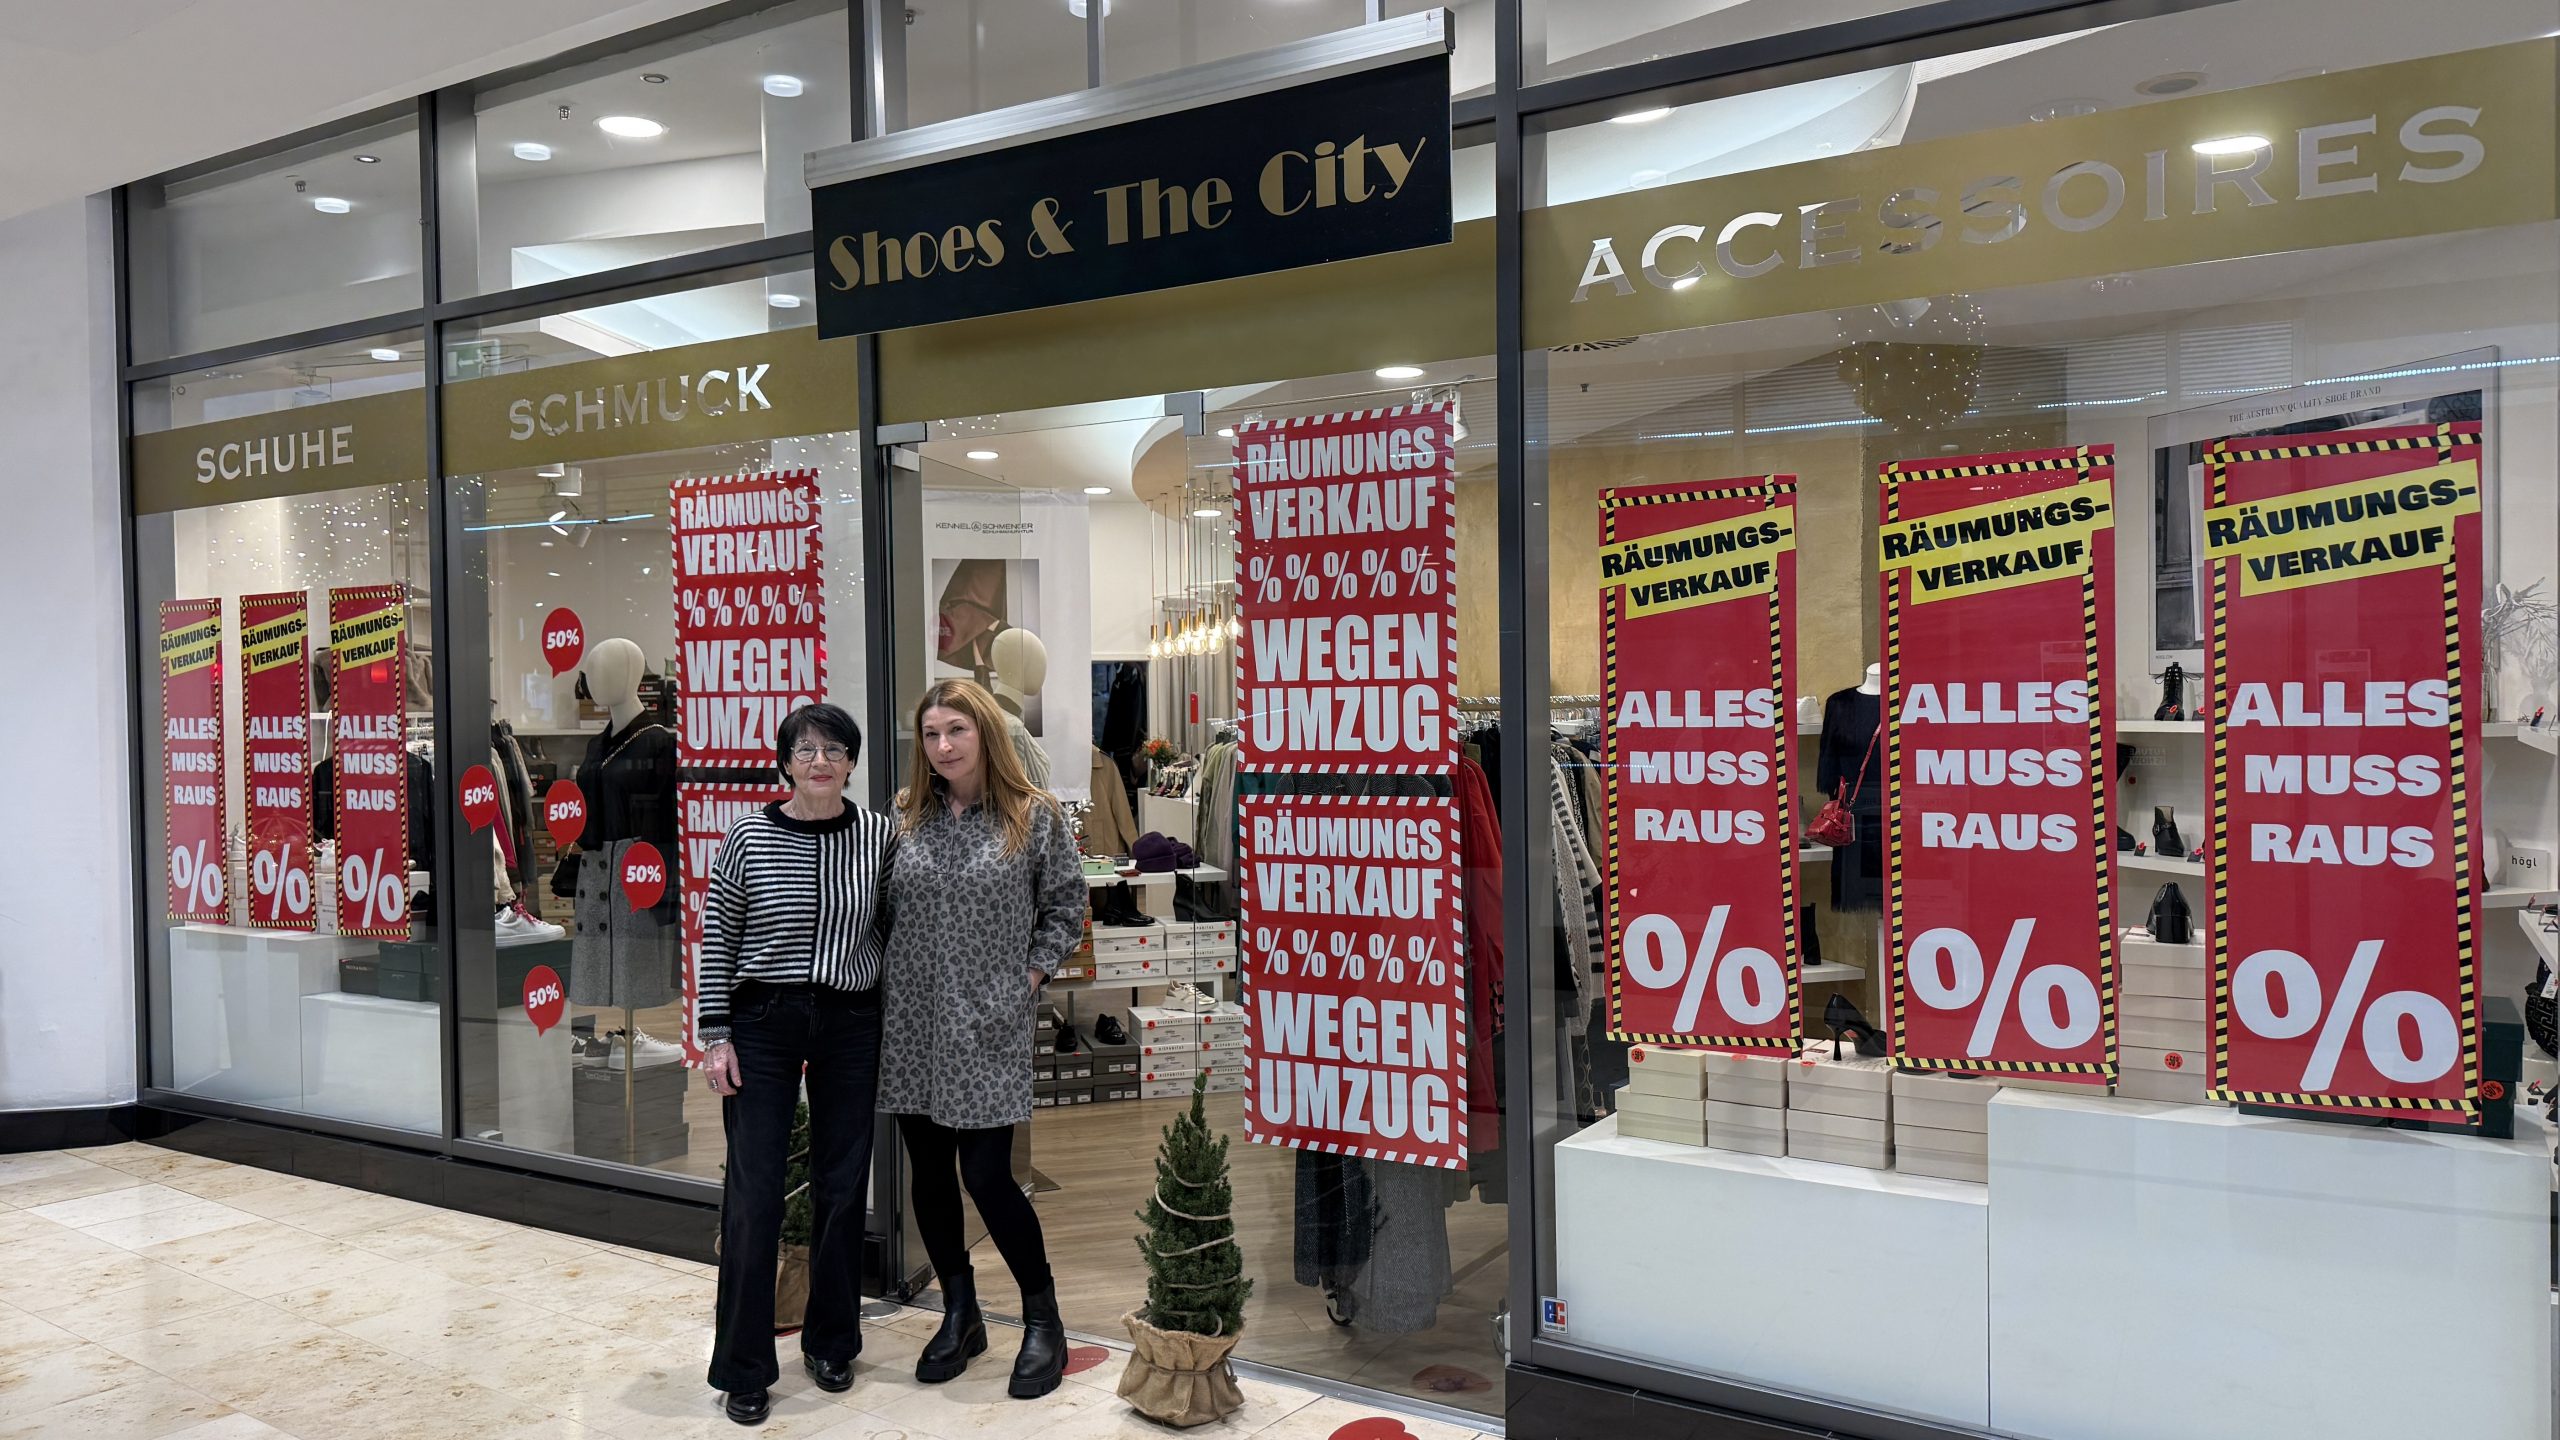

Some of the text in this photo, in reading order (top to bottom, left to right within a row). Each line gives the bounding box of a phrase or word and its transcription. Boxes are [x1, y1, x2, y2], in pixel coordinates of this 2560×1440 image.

[828, 133, 1427, 291] Shoes & The City
[1570, 105, 2487, 304] ACCESSOIRES
[509, 363, 773, 441] SCHMUCK
[2325, 392, 2347, 404] SHOE
[2350, 386, 2381, 399] BRAND
[195, 424, 354, 484] SCHUHE
[1247, 425, 1436, 484] RÄUMUNGS
[680, 487, 810, 531] RÄUMUNGS
[935, 522, 971, 530] KENNEL
[1248, 475, 1437, 540] VERKAUF
[1882, 496, 2110, 561] RÄUMUNGS-
[2207, 478, 2477, 548] RÄUMUNGS-
[681, 530, 812, 577] VERKAUF
[1601, 520, 1793, 578] RÄUMUNGS-
[1917, 539, 2085, 591] VERKAUF
[2247, 526, 2445, 582] VERKAUF
[1630, 561, 1772, 607] VERKAUF
[161, 625, 221, 651] RÄUMUNGS-
[241, 617, 307, 649] RÄUMUNGS-
[331, 612, 404, 645] RÄUMUNGS-
[342, 636, 397, 663] VERKAUF
[546, 629, 580, 651] 50%
[1251, 612, 1439, 682] WEGEN
[170, 646, 216, 670] VERKAUF
[252, 641, 301, 667] VERKAUF
[684, 637, 816, 693] WEGEN
[686, 695, 814, 750] UMZU
[1251, 683, 1440, 753] UMZUG
[1616, 688, 1775, 728] ALLES
[1900, 679, 2090, 724] ALLES
[2227, 679, 2450, 728] ALLES
[167, 716, 219, 740] ALLES
[249, 715, 304, 740] ALLES
[338, 714, 400, 740] ALLES
[171, 751, 217, 773] MUSS
[254, 752, 303, 774] MUSS
[343, 752, 398, 776] MUSS
[1629, 750, 1770, 785] MUSS
[1915, 747, 2083, 787] MUSS
[2244, 754, 2443, 797] MUSS
[173, 785, 216, 806] RAUS
[256, 787, 302, 809] RAUS
[346, 789, 397, 812] RAUS
[464, 785, 495, 805] 50%
[549, 800, 582, 821] 50%
[1254, 809, 1442, 861] RÄUMUNGS
[1634, 808, 1766, 845] RAUS
[1921, 812, 2078, 852] RAUS
[2251, 823, 2435, 868] RAUS
[171, 839, 223, 914] %
[253, 843, 311, 921] %
[342, 847, 405, 929] %
[625, 865, 662, 884] 50%
[1255, 862, 1443, 920] VERKAUF
[1622, 904, 1786, 1033] %
[1907, 918, 2101, 1058] %
[528, 983, 560, 1009] 50%
[2231, 939, 2460, 1092] %
[1258, 989, 1448, 1070] WEGEN
[1259, 1058, 1450, 1144] UMZUG
